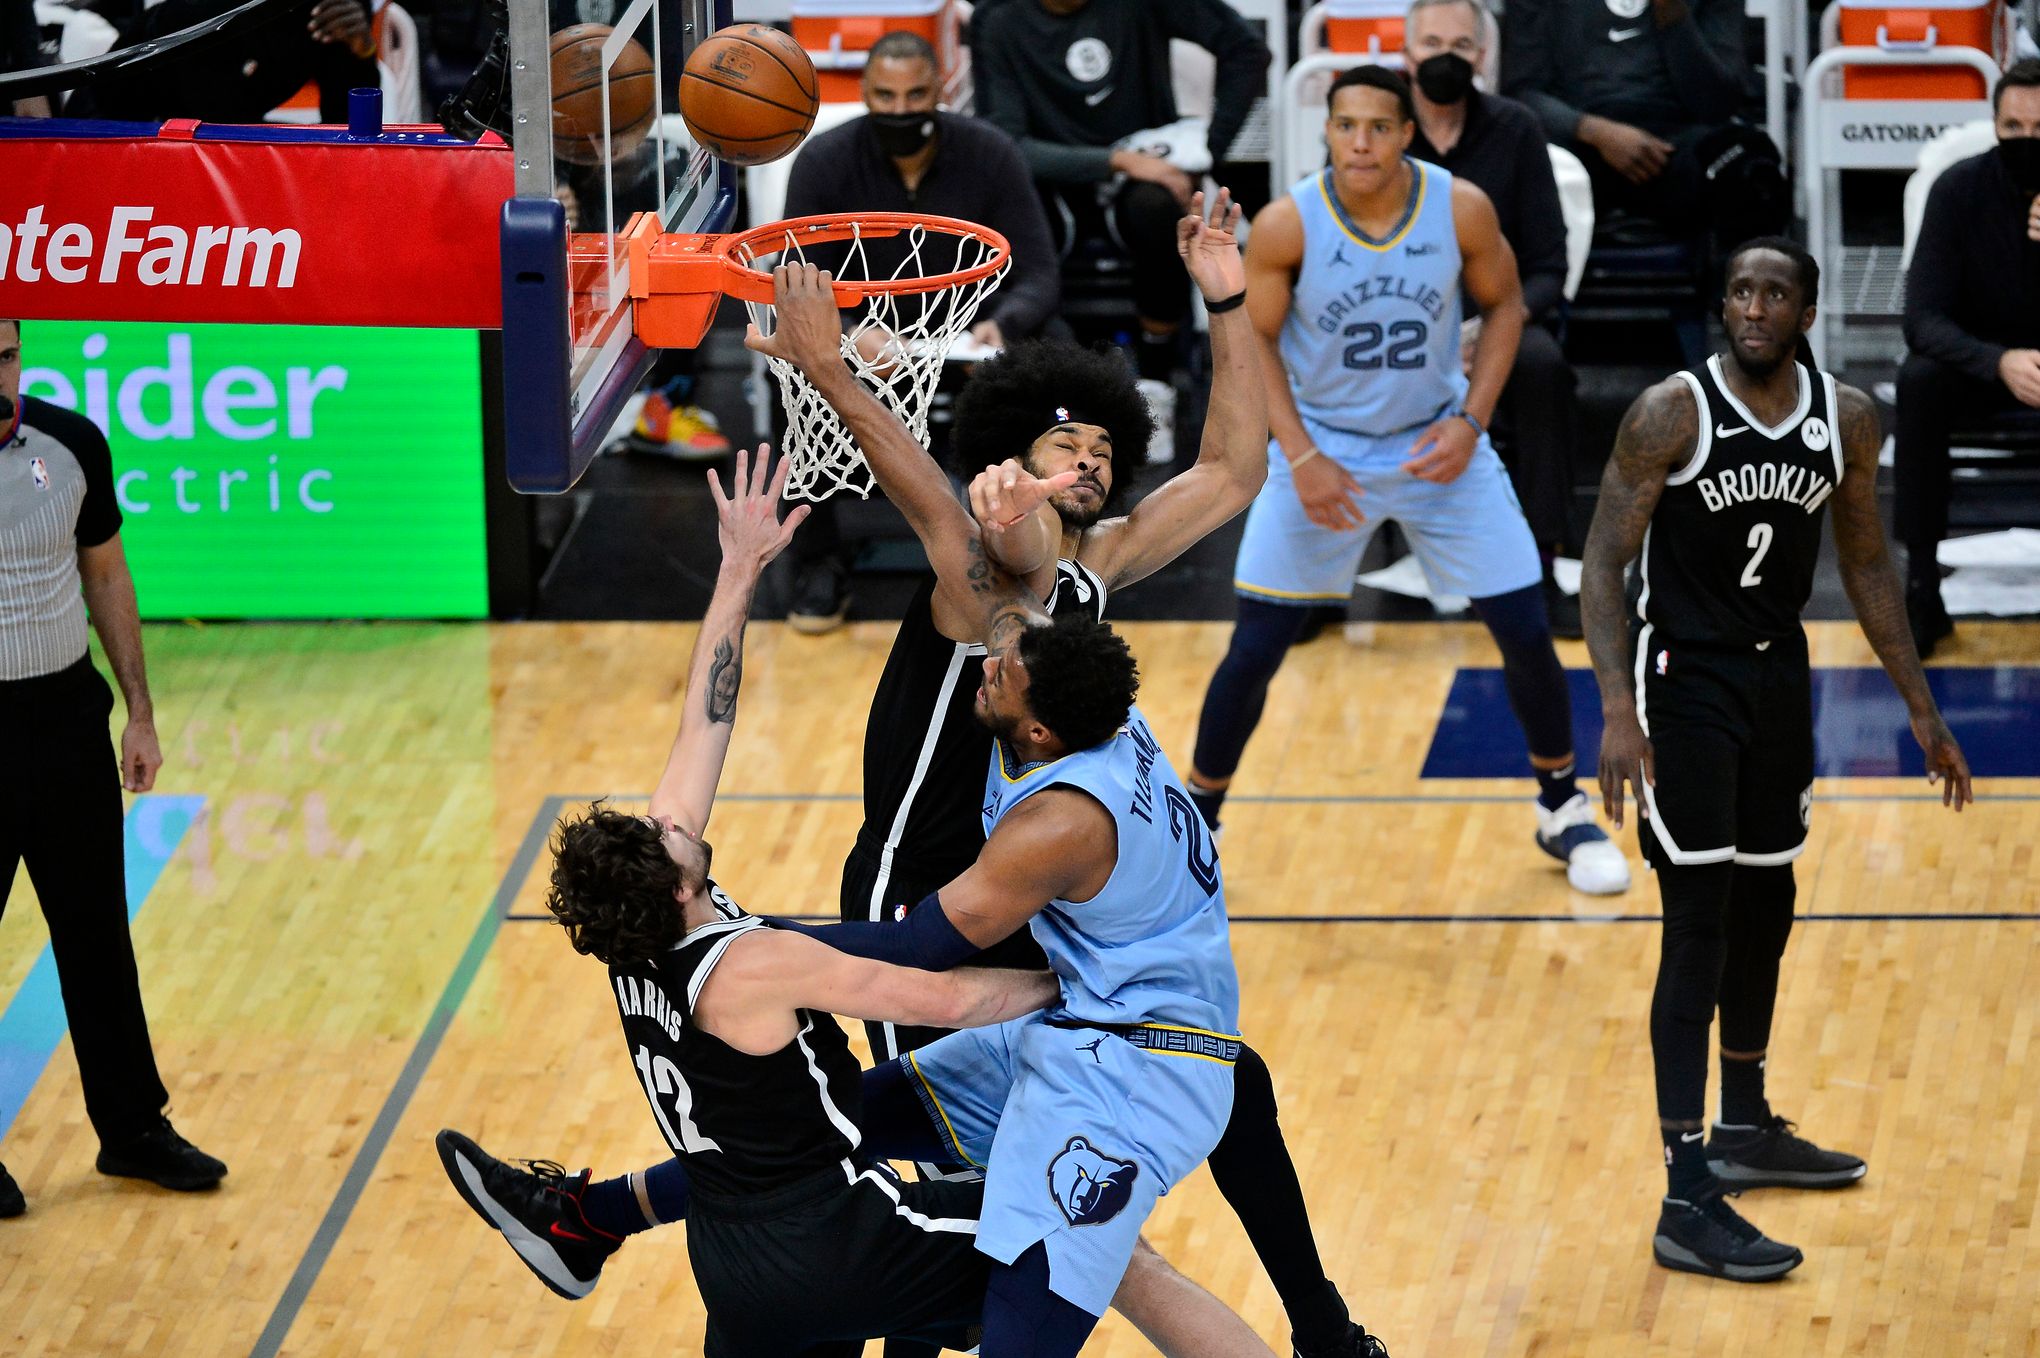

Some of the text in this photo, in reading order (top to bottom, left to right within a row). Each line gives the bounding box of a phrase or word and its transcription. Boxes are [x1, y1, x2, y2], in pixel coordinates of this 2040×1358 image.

[98, 206, 302, 288] Farm
[1343, 320, 1427, 370] 22
[116, 454, 334, 513] ctric
[1740, 522, 1774, 588] 2
[1164, 784, 1220, 898] 2
[616, 975, 682, 1043] HARRIS
[626, 1044, 724, 1154] 12
